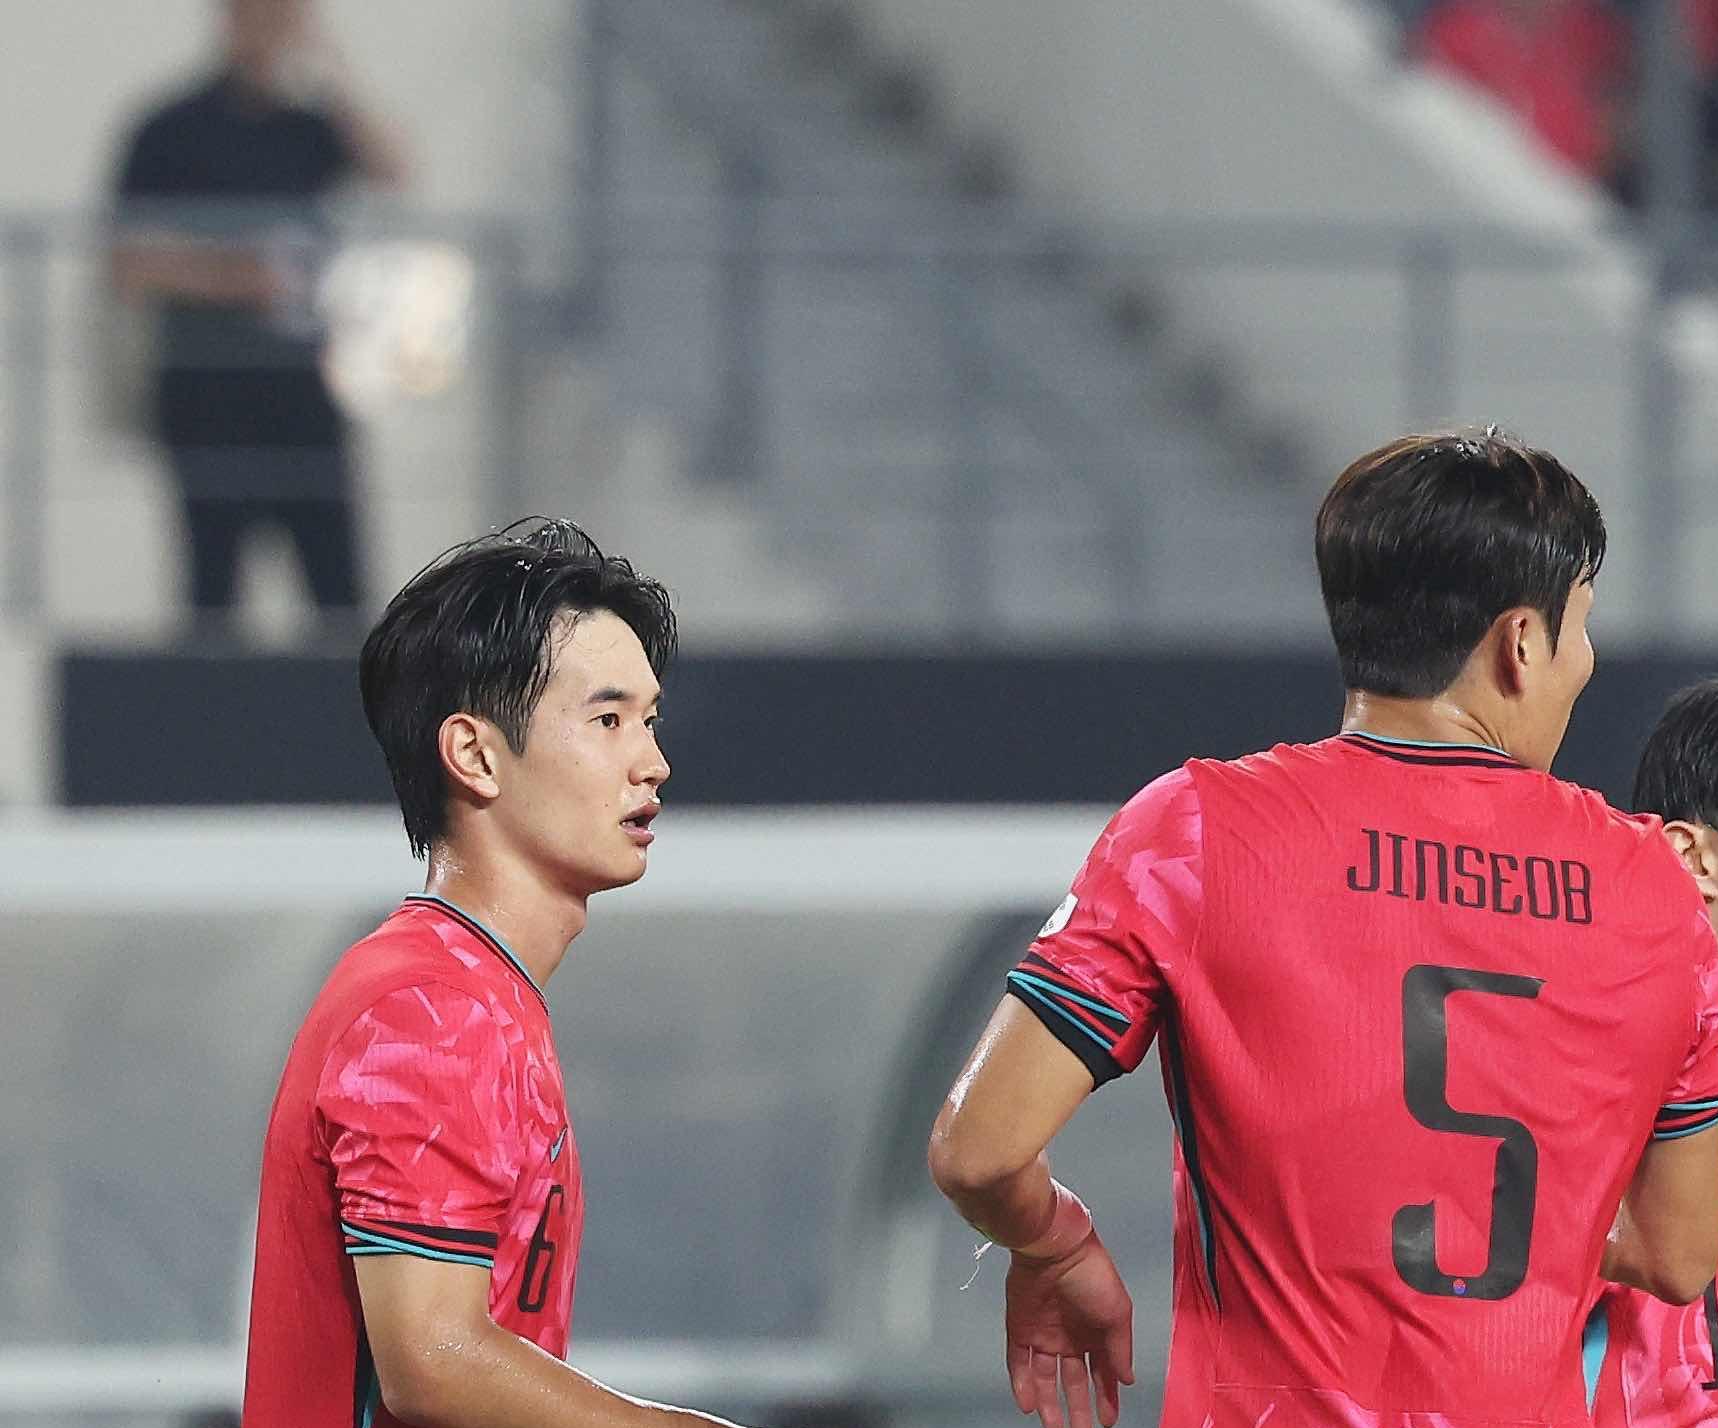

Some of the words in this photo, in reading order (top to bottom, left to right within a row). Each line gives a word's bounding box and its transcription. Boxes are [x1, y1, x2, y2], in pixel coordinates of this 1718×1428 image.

[1346, 828, 1592, 925] JINSEOB
[1391, 964, 1546, 1301] 5
[517, 1184, 565, 1313] 6
